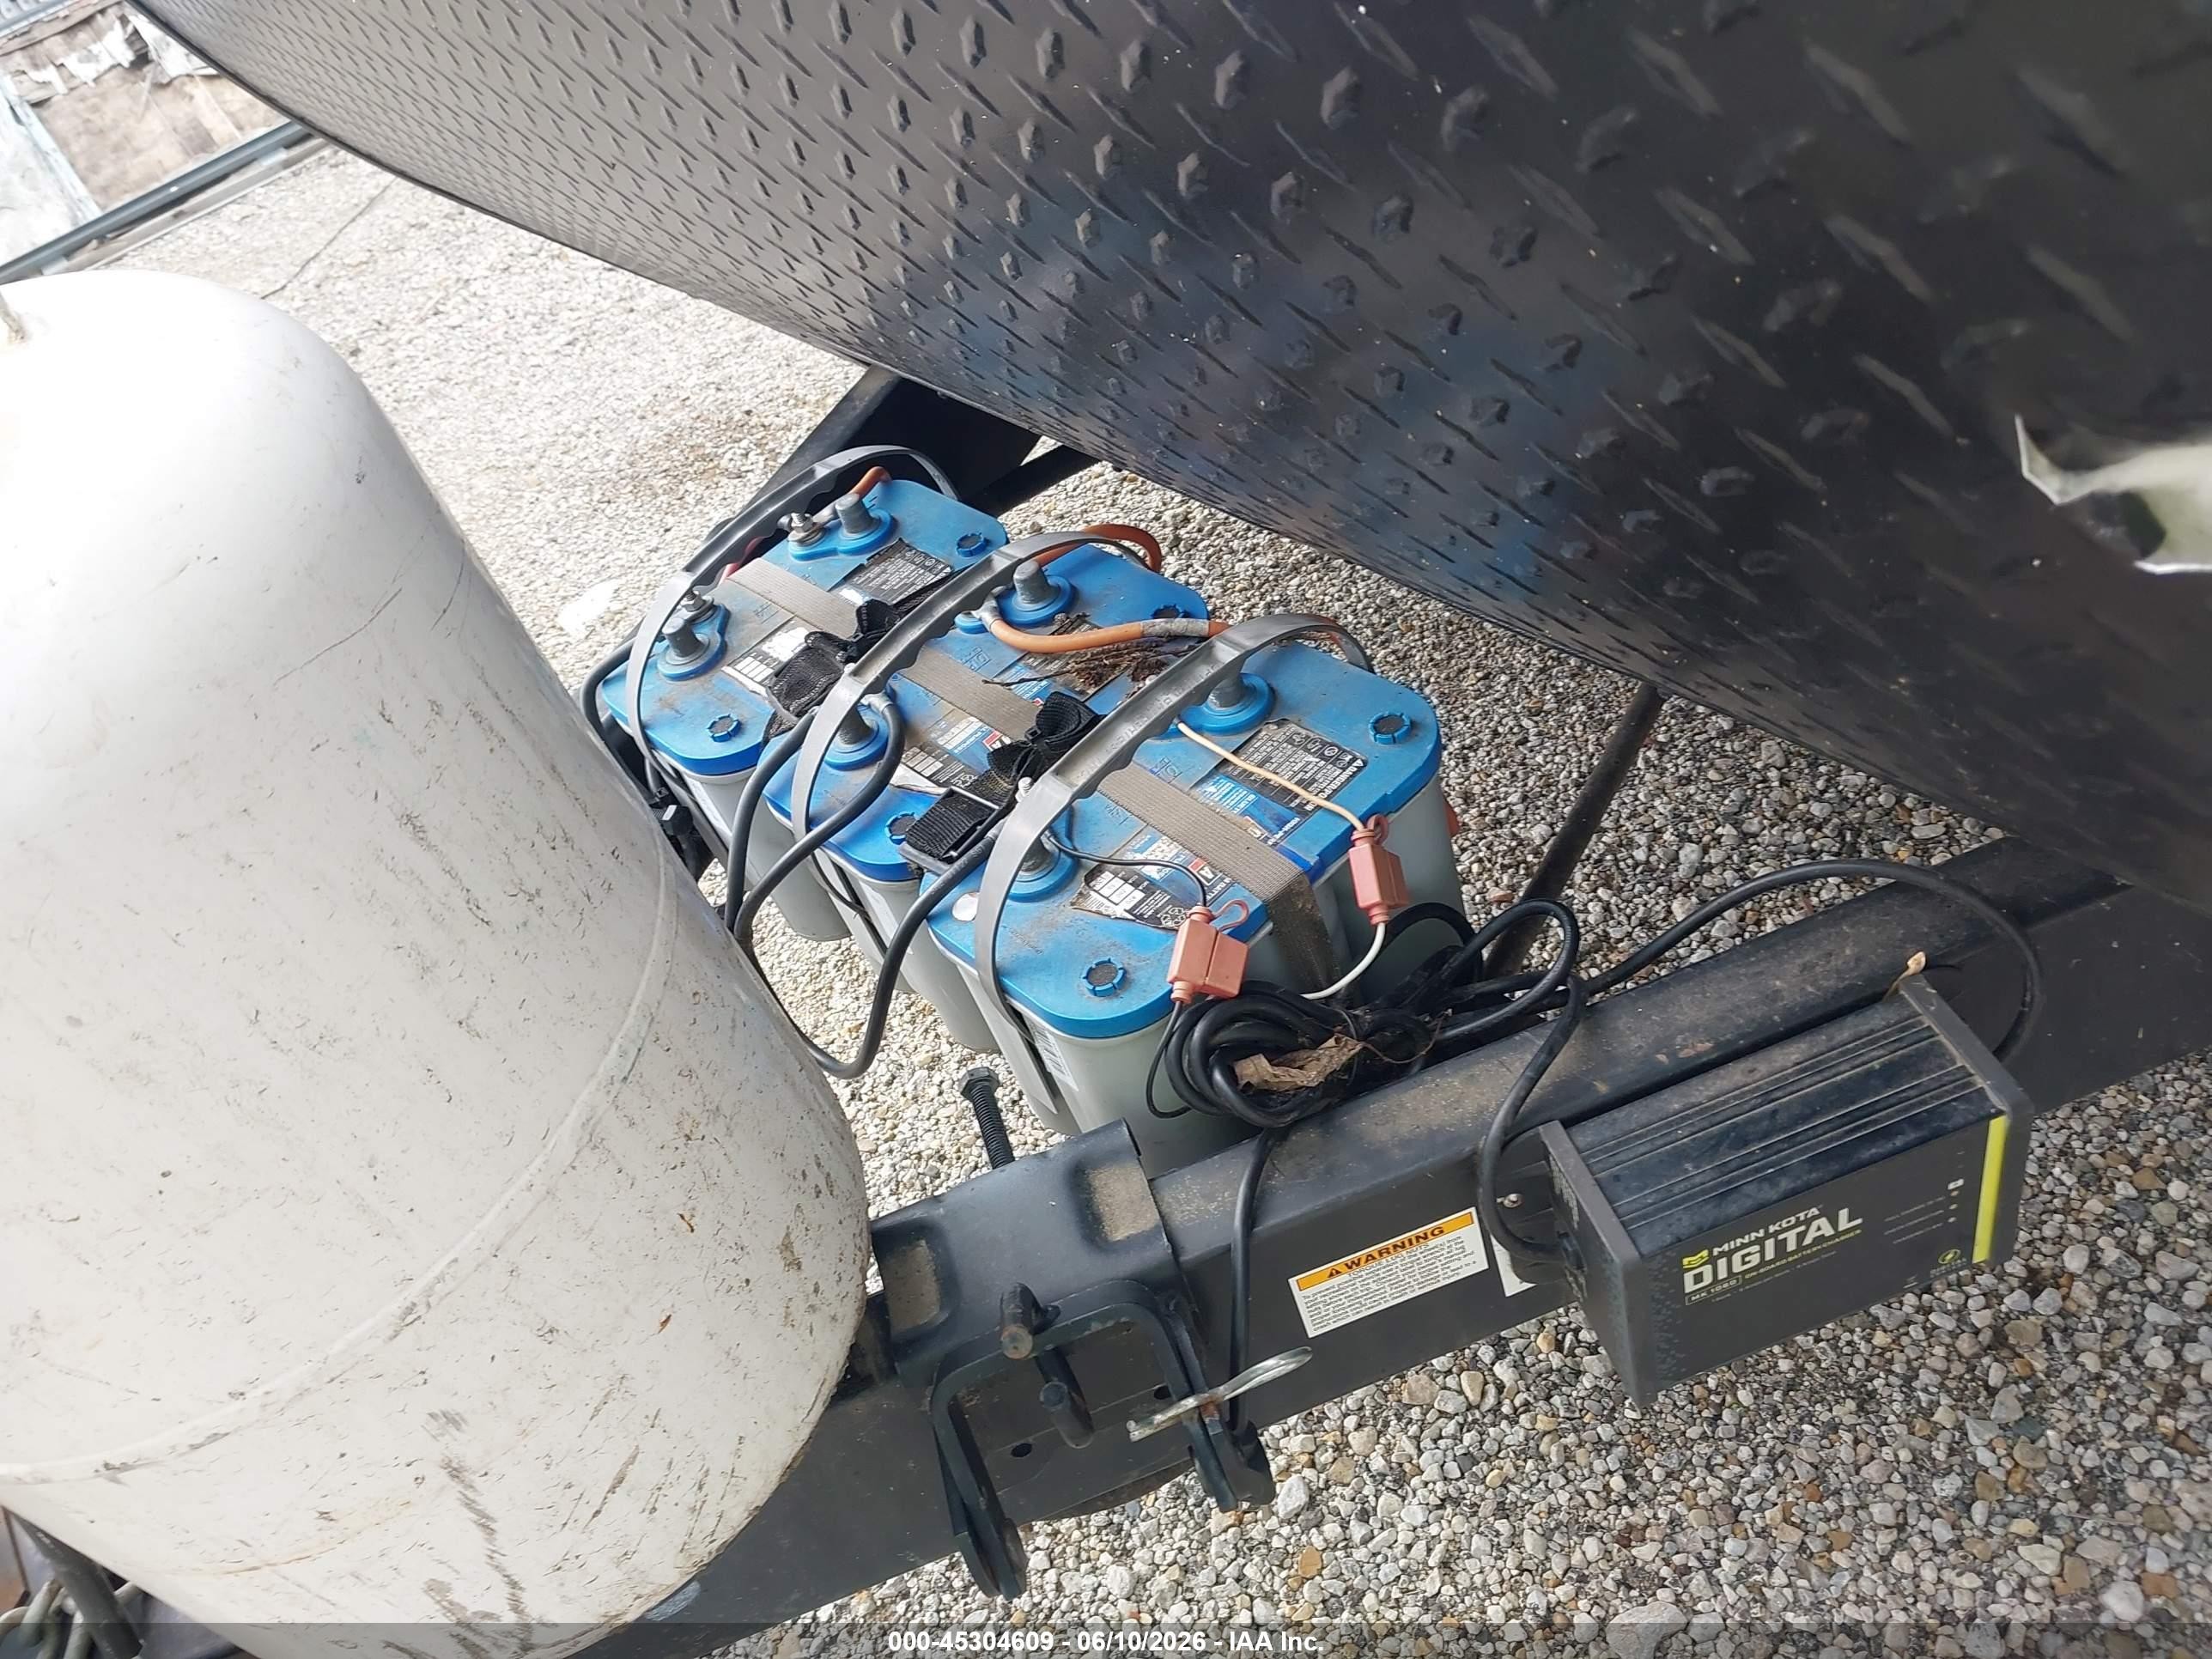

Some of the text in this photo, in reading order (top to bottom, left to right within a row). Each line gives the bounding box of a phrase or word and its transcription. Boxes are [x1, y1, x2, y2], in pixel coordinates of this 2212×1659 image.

[1344, 1224, 1444, 1271] WARNING
[1405, 1242, 1429, 1255] NUTS
[1684, 1208, 1863, 1293] DIGITAL
[1712, 1207, 1820, 1256] MINN KOTA
[1691, 1291, 1708, 1301] MK
